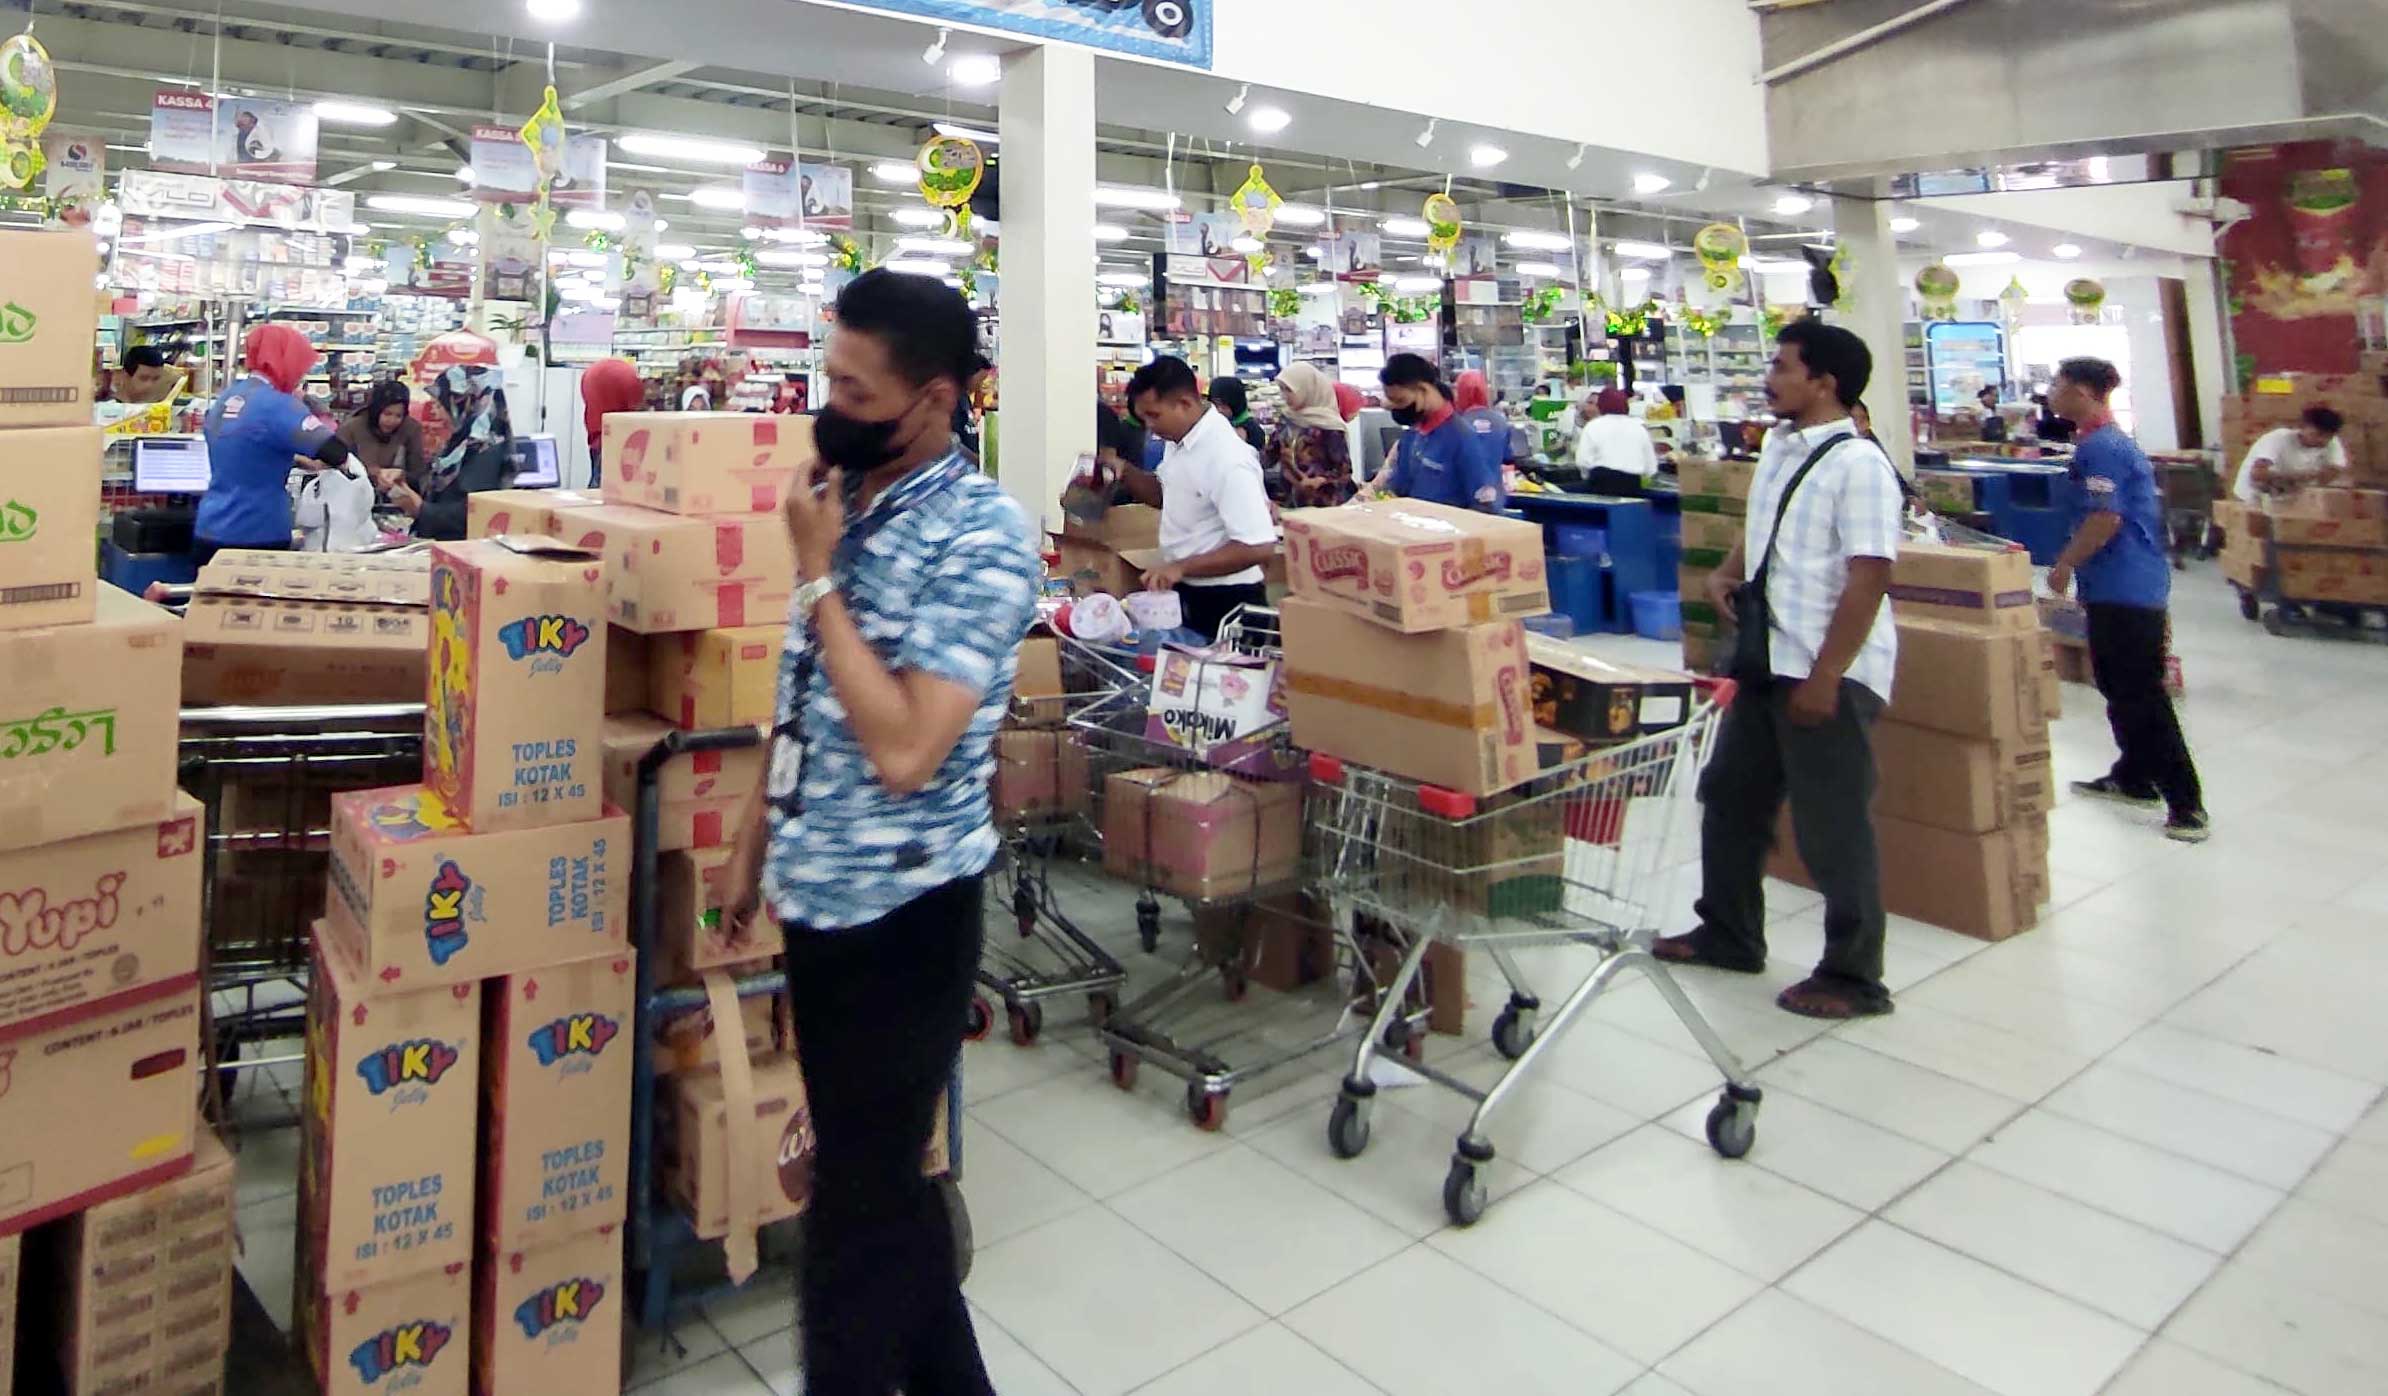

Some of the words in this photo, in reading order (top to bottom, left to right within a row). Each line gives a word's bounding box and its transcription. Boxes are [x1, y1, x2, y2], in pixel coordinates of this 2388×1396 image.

[158, 94, 203, 108] KASSA
[476, 128, 513, 140] KASSA
[498, 615, 589, 661] TIKY
[1164, 709, 1237, 741] Mikako
[512, 739, 576, 762] TOPLES
[514, 762, 571, 787] KOTAK
[498, 791, 518, 808] ISI
[533, 787, 549, 803] 12
[567, 783, 585, 798] 45
[548, 856, 567, 928] TOPLES
[571, 856, 589, 920] KOTAK
[0, 871, 127, 956] Yupi
[425, 859, 471, 966] TIKY
[528, 1011, 619, 1067] TIKY
[356, 1037, 459, 1096] TIKY
[541, 1139, 604, 1172] TOPLES
[372, 1173, 442, 1208] TOPLES
[542, 1165, 600, 1199] KOTAK
[373, 1202, 437, 1235] KOTAK
[561, 1195, 577, 1213] 12
[356, 1242, 377, 1261] ISI
[394, 1234, 412, 1251] 12
[433, 1221, 453, 1240] 45
[514, 1278, 604, 1339] TIKY
[349, 1319, 452, 1385] TIKY
